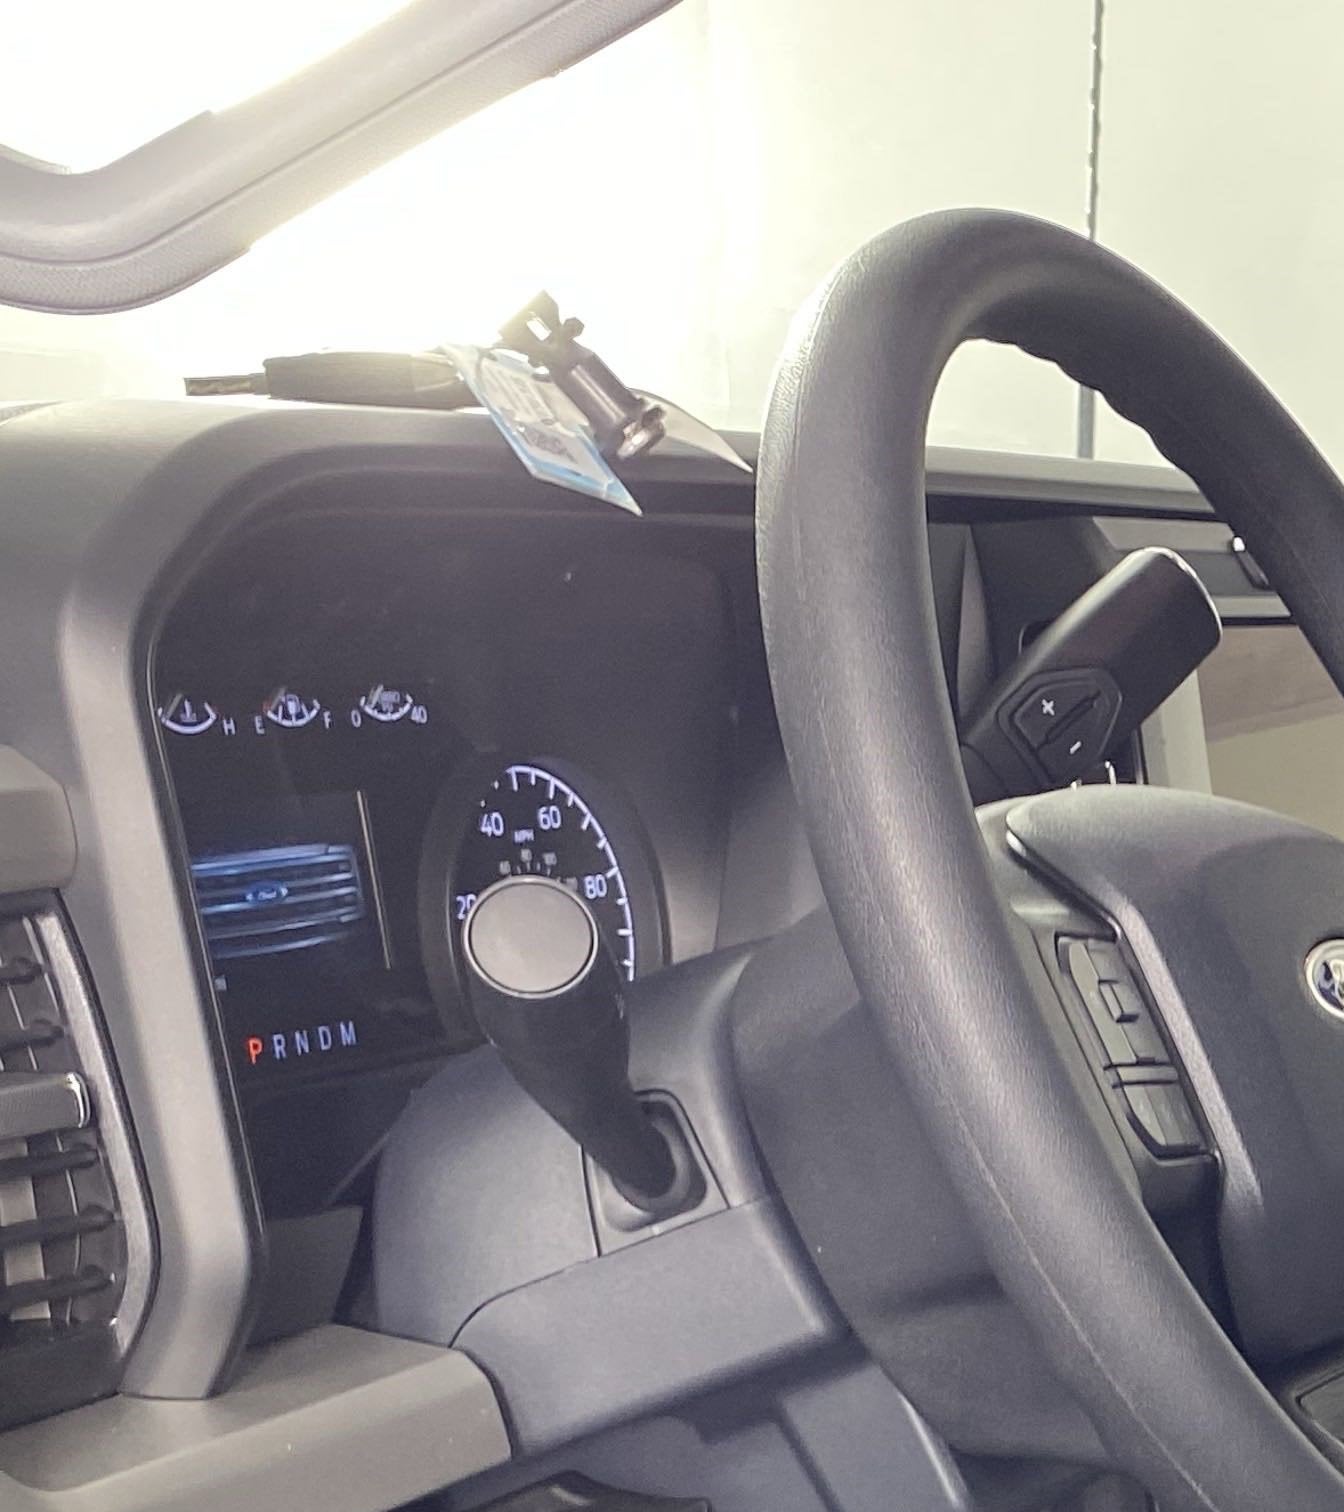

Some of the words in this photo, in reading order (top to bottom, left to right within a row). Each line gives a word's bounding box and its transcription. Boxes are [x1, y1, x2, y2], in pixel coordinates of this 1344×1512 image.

[223, 716, 236, 735] H
[254, 715, 266, 735] E
[323, 710, 334, 729] F
[411, 706, 428, 725] 40
[480, 811, 504, 837] 40
[537, 805, 561, 830] 60
[584, 873, 608, 899] 80
[247, 1037, 263, 1064] P
[273, 1034, 287, 1061] R
[294, 1029, 310, 1056] N
[319, 1026, 333, 1051] D
[340, 1020, 356, 1046] M
